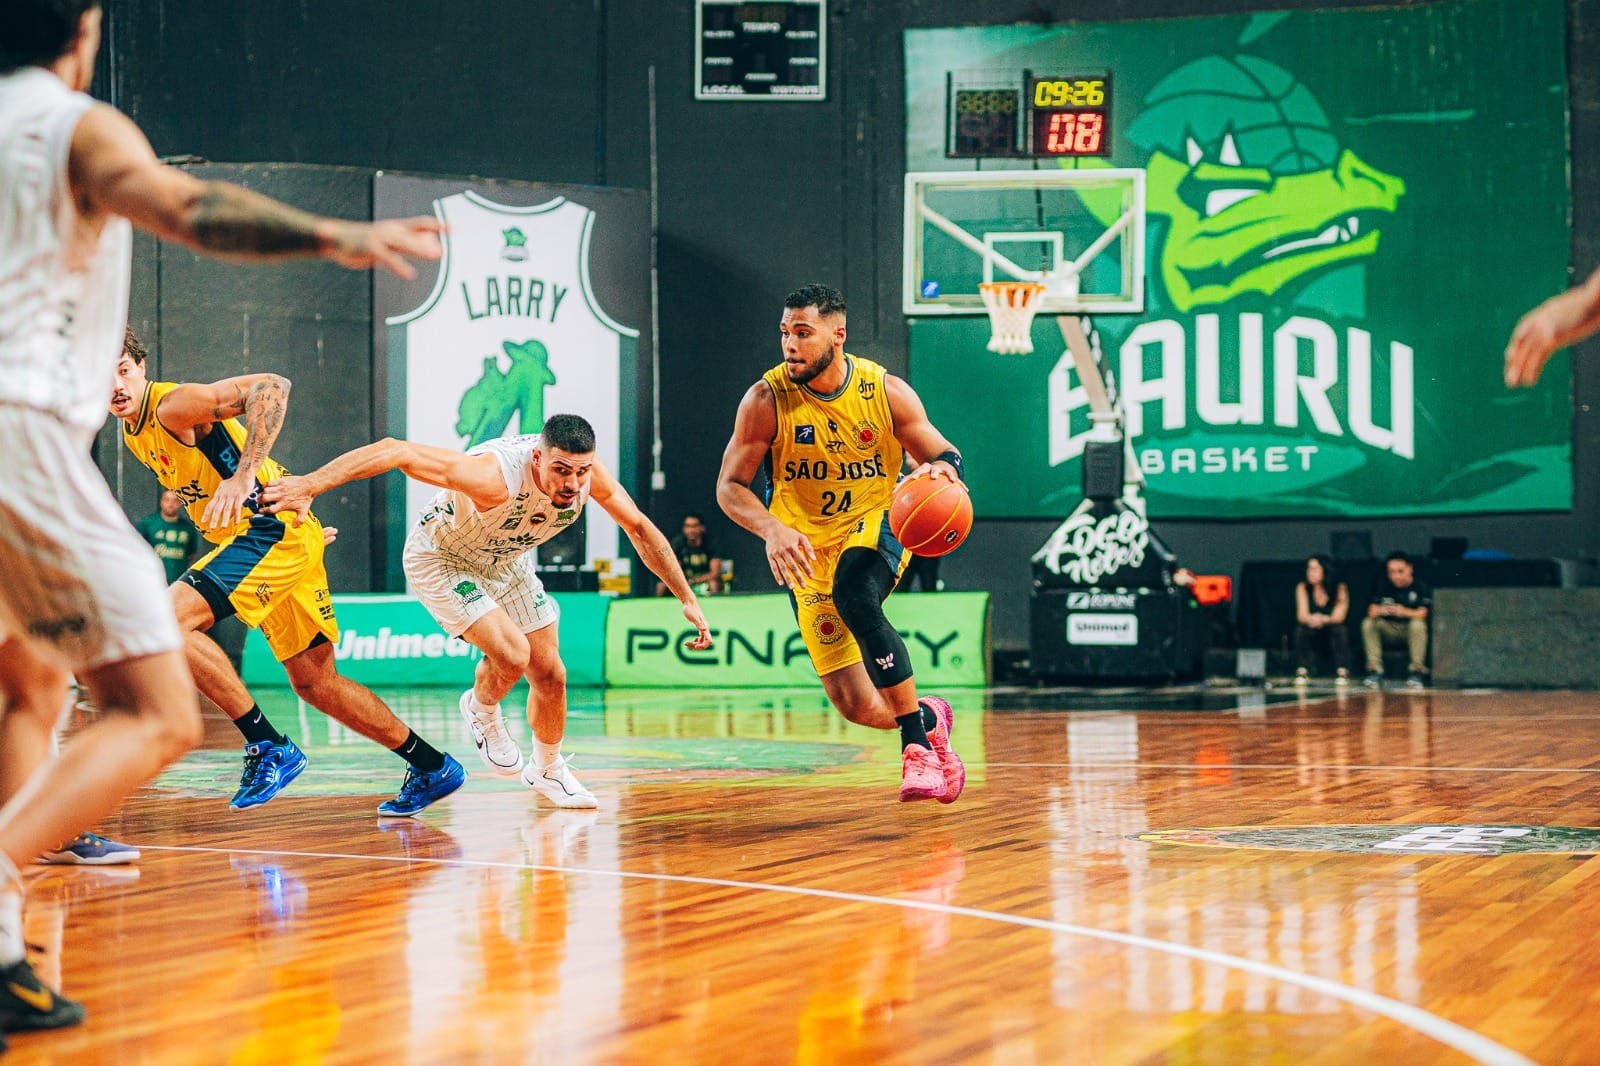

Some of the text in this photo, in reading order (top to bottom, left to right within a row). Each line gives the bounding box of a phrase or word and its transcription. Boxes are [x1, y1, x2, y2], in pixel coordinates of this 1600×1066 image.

[1034, 81, 1104, 107] 09:26
[1047, 113, 1103, 153] 08
[462, 277, 567, 322] LARRY
[784, 450, 887, 482] SÃO JOSÉ
[1140, 446, 1319, 474] BASKET
[822, 490, 852, 517] 24
